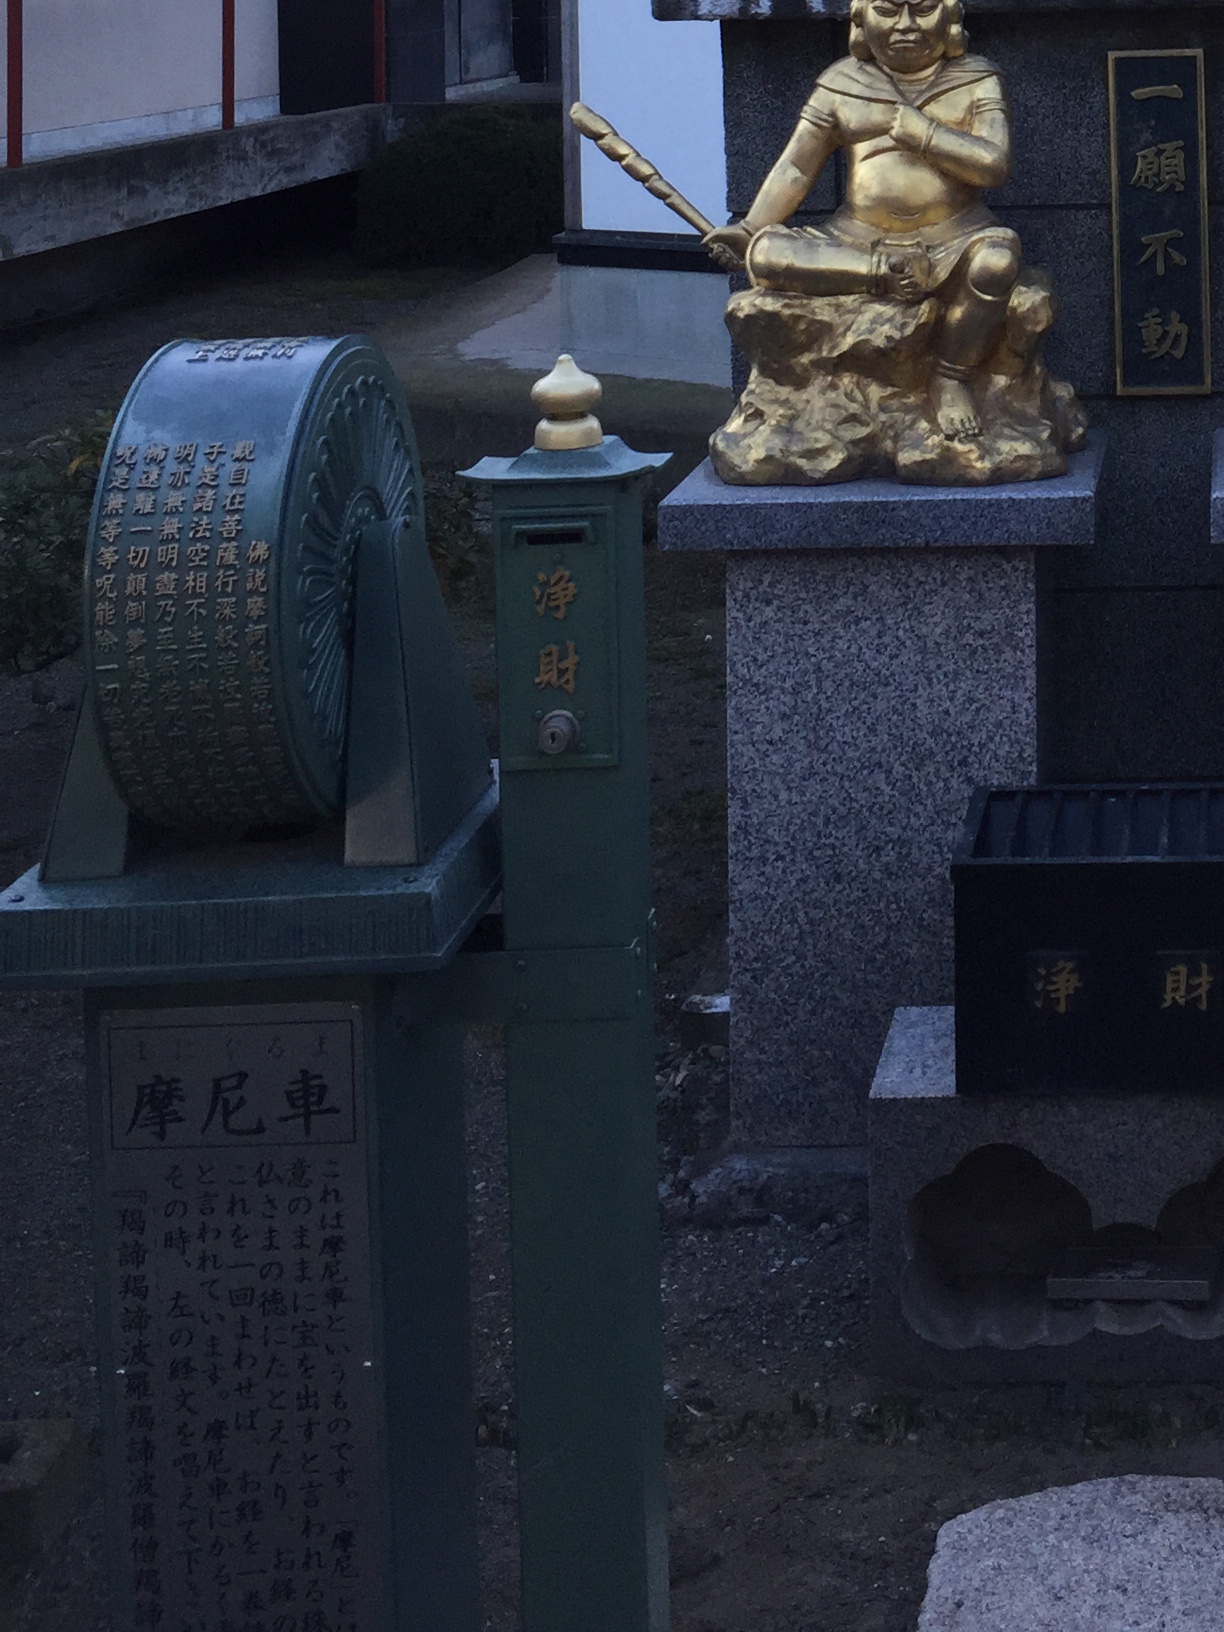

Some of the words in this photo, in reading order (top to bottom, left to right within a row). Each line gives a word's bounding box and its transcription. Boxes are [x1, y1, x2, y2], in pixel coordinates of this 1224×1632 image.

[1130, 83, 1189, 360] 一願不動
[532, 571, 580, 695] 浄財
[1033, 960, 1215, 1015] 浄財
[125, 1068, 341, 1142] 摩尼車
